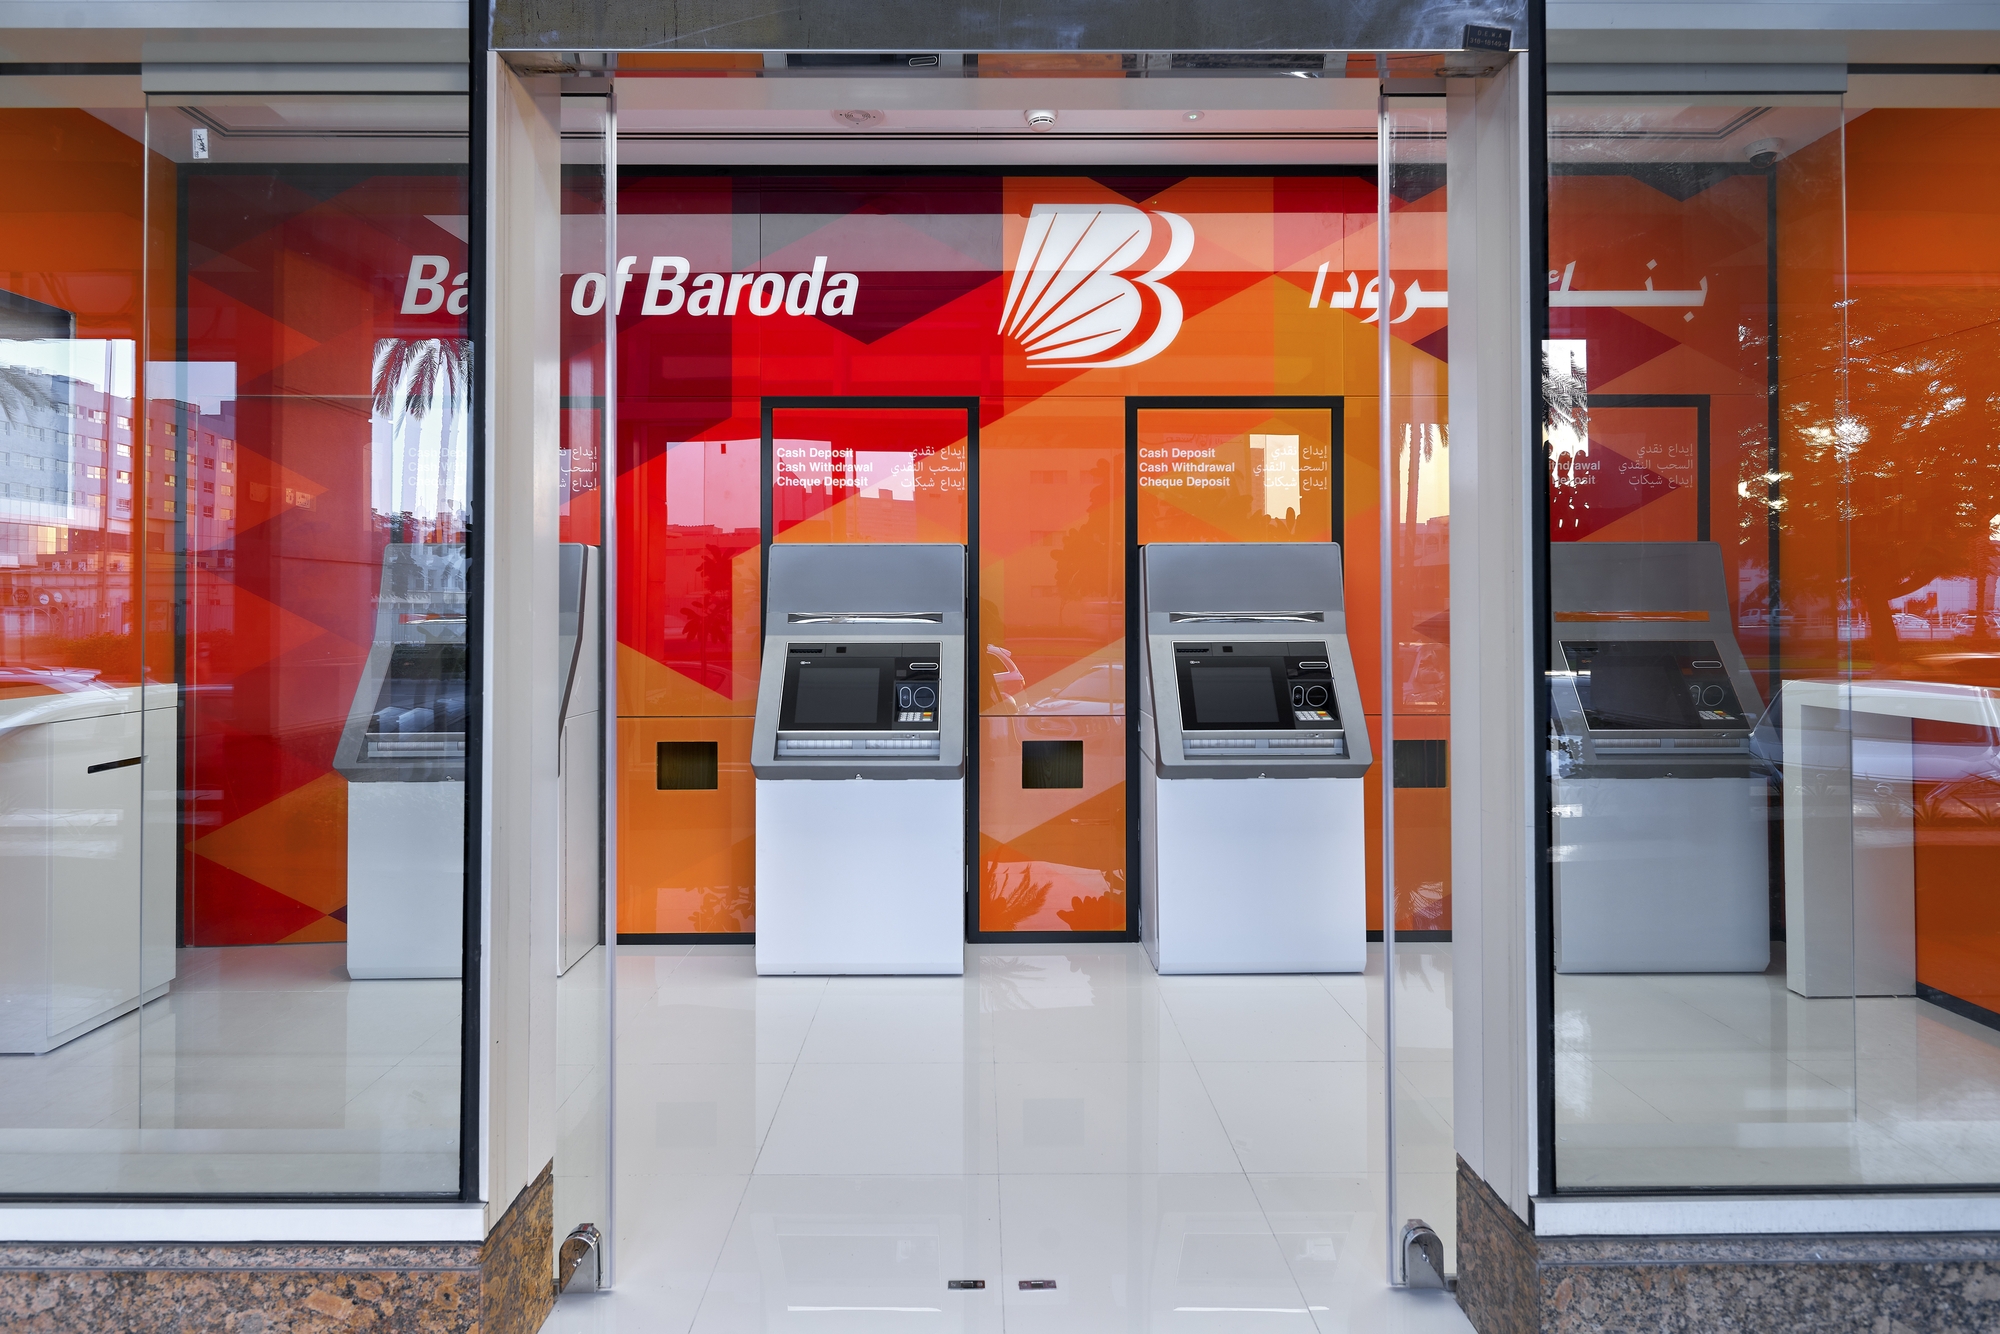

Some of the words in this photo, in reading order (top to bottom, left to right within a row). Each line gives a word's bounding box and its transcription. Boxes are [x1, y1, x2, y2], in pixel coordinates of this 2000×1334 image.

[570, 255, 637, 316] of
[641, 255, 859, 317] Baroda
[1308, 260, 1448, 324] رودا
[572, 446, 597, 460] إيداع
[776, 447, 806, 458] Cash
[809, 447, 853, 461] Deposit
[909, 446, 935, 459] نقدي
[940, 446, 966, 459] إيداع
[1139, 447, 1169, 458] Cash
[1171, 447, 1216, 461] Deposit
[1271, 446, 1297, 459] نقدي
[1302, 446, 1328, 459] إيداع
[1637, 445, 1663, 458] نقدي
[1668, 444, 1693, 458] إيداع
[560, 461, 598, 475] السحب
[776, 461, 806, 472] Cash
[809, 461, 873, 473] Withdrawal
[890, 461, 924, 476] النقدي
[928, 461, 966, 474] السحب
[1139, 461, 1169, 473] Cash
[1171, 461, 1235, 473] Withdrawal
[1252, 461, 1286, 476] النقدي
[1290, 461, 1328, 474] السحب
[1618, 460, 1651, 475] النقدي
[1656, 460, 1693, 473] السحب
[572, 476, 597, 491] إيداع
[776, 476, 821, 489] Cheque
[824, 476, 868, 489] Deposit
[900, 476, 935, 490] شيكات
[940, 476, 966, 490] إيداع
[1139, 476, 1183, 489] Cheque
[1186, 476, 1230, 489] Deposit
[1263, 476, 1298, 490] شيكات
[1302, 476, 1328, 490] إيداع
[1629, 475, 1663, 489] شيكات
[1668, 475, 1693, 489] إيداع
